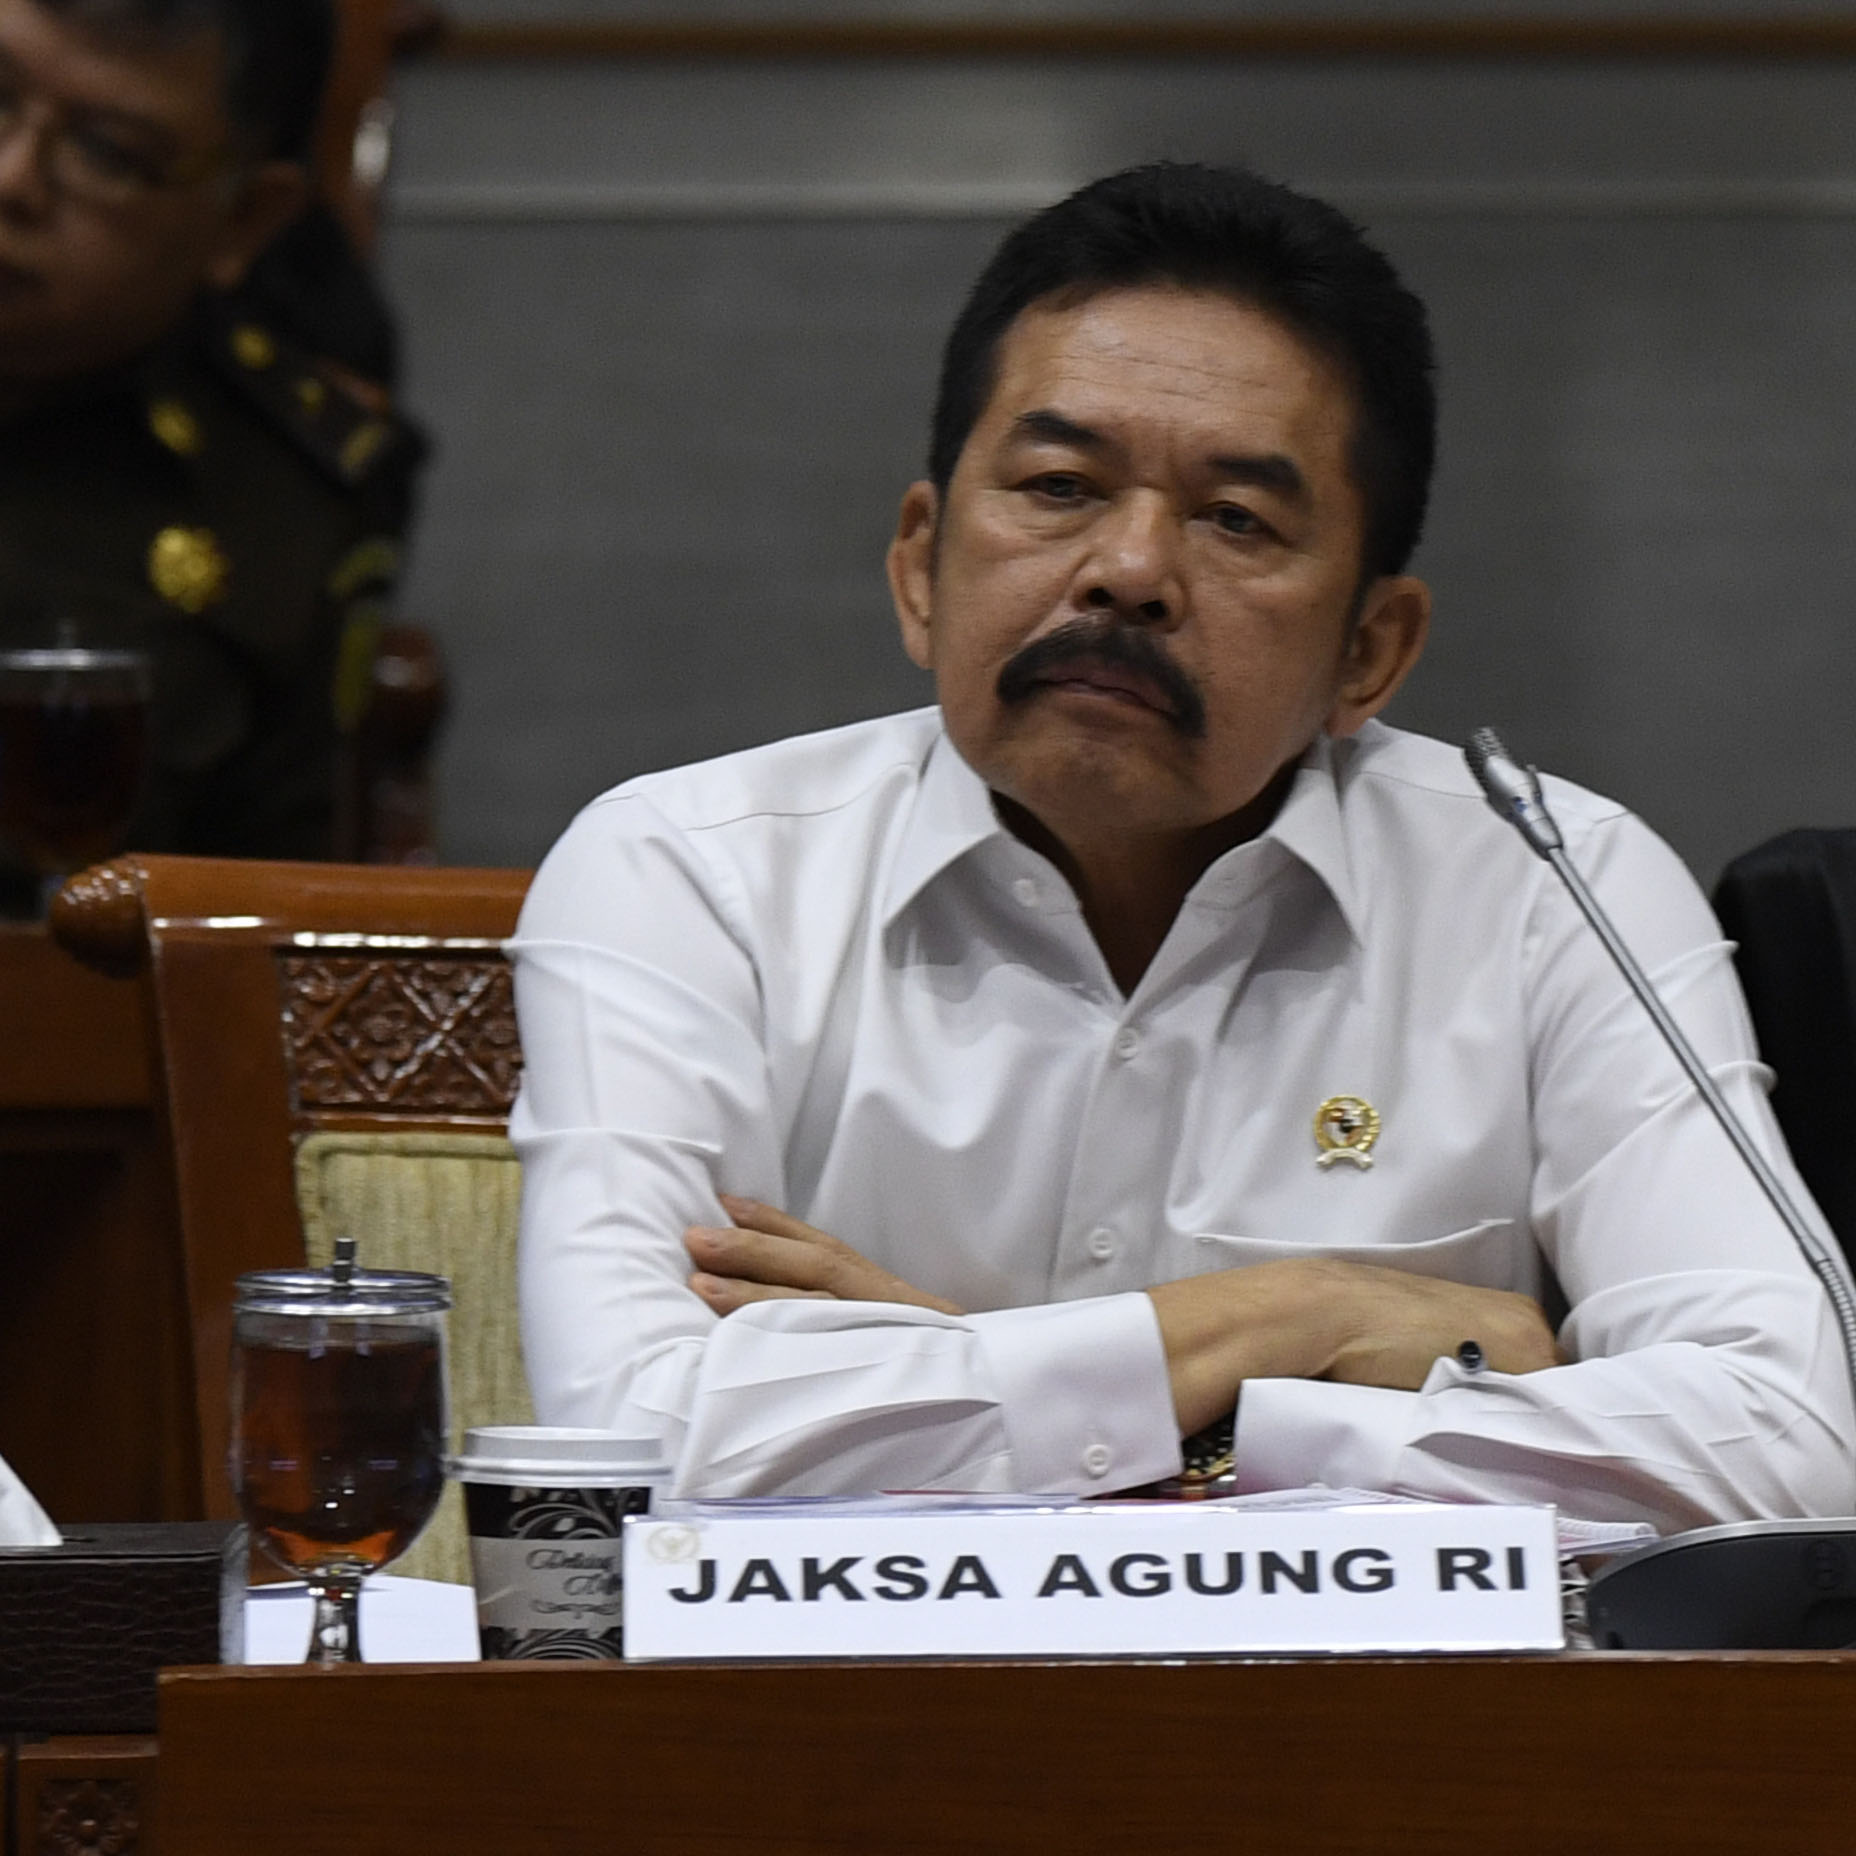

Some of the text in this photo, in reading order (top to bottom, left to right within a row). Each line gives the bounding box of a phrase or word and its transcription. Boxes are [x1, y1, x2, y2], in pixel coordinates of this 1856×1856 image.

[668, 1555, 1002, 1604] JAKSA
[1037, 1548, 1395, 1599] AGUNG
[1436, 1546, 1526, 1592] RI
